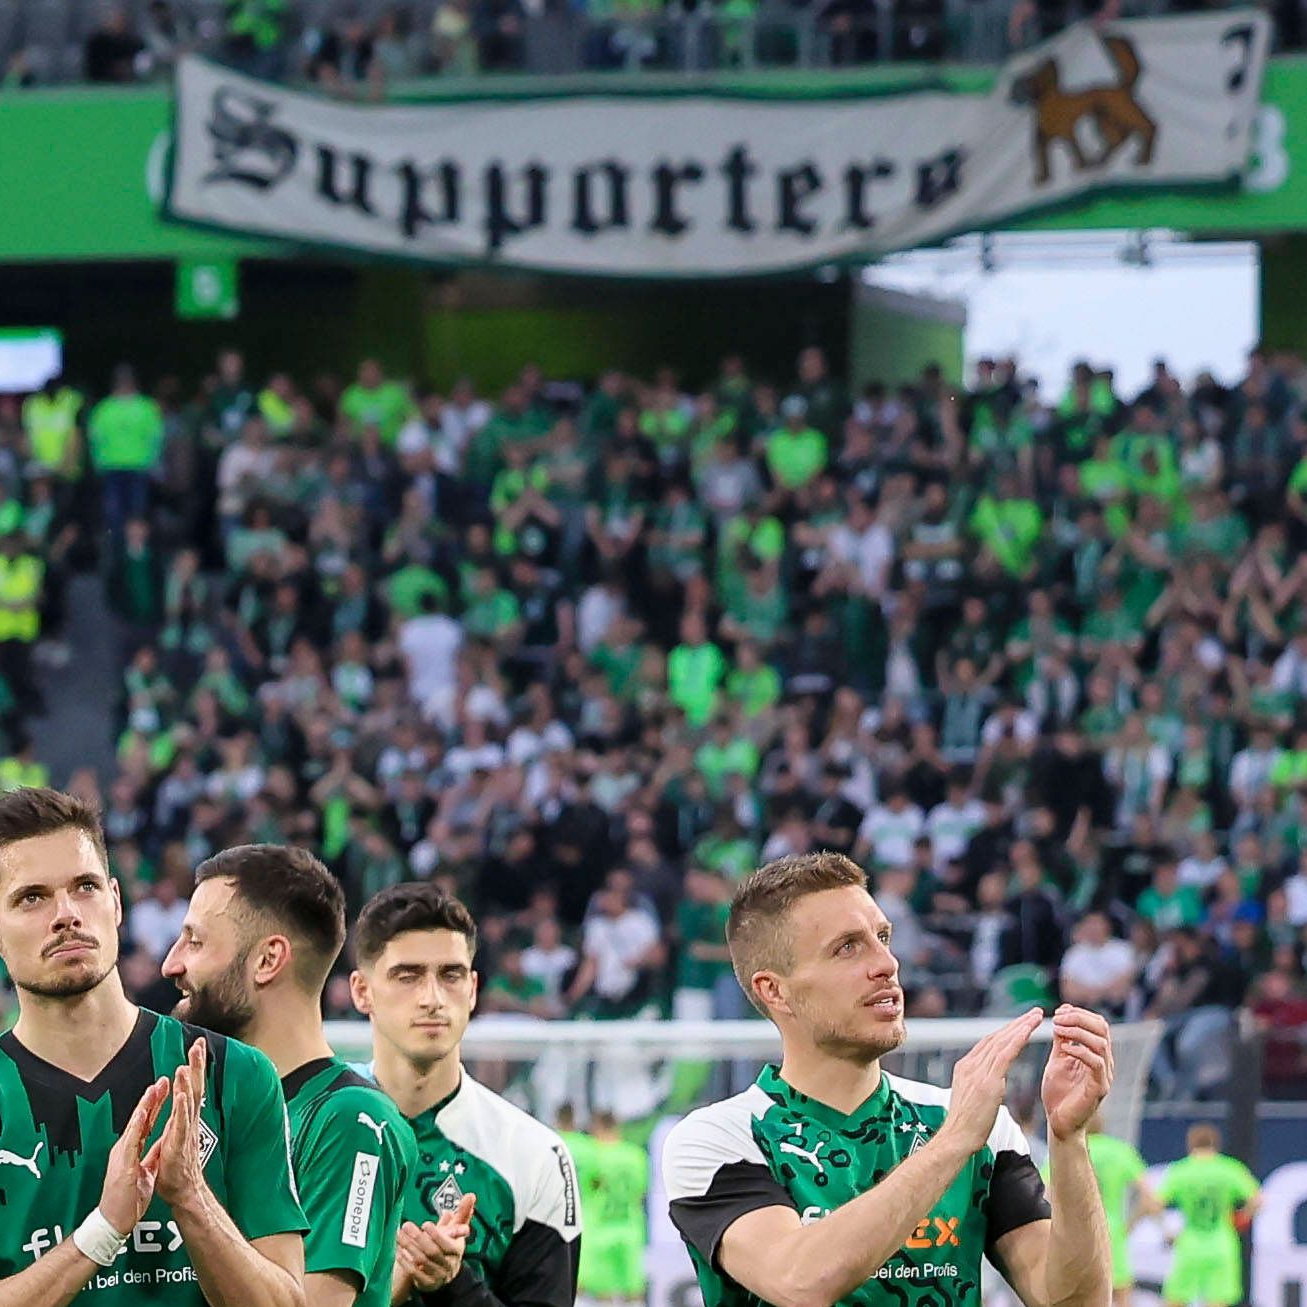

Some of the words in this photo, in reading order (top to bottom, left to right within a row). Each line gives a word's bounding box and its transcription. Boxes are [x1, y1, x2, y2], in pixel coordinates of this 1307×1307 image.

[201, 84, 974, 252] Supporters
[350, 1178, 368, 1241] sonepar
[97, 1268, 120, 1290] bei
[123, 1266, 153, 1286] den
[895, 1265, 920, 1279] den
[923, 1262, 959, 1278] Profis
